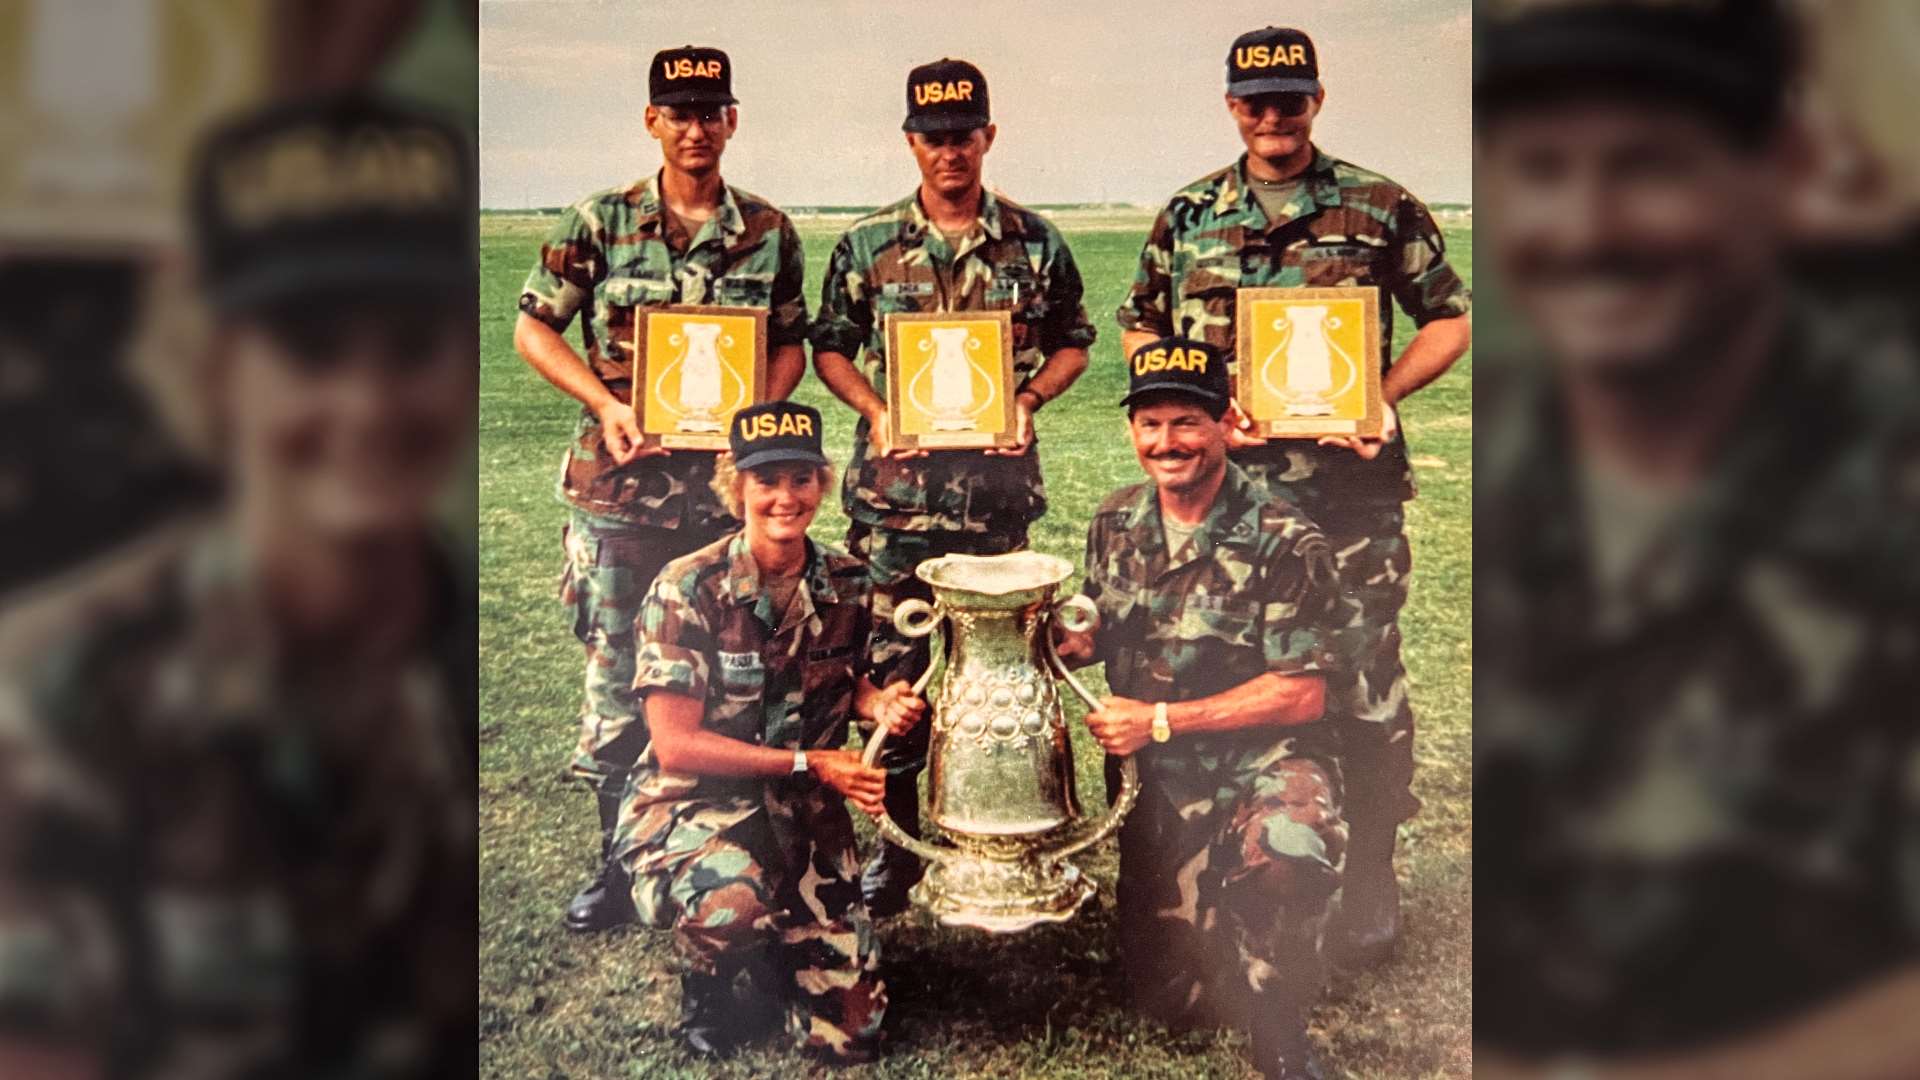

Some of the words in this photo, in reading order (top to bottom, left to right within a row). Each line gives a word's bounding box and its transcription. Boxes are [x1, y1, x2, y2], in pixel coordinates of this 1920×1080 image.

[663, 58, 722, 80] USAR
[1236, 43, 1307, 69] USAR
[914, 79, 975, 105] USAR
[1133, 346, 1208, 377] USAR
[739, 412, 814, 442] USAR
